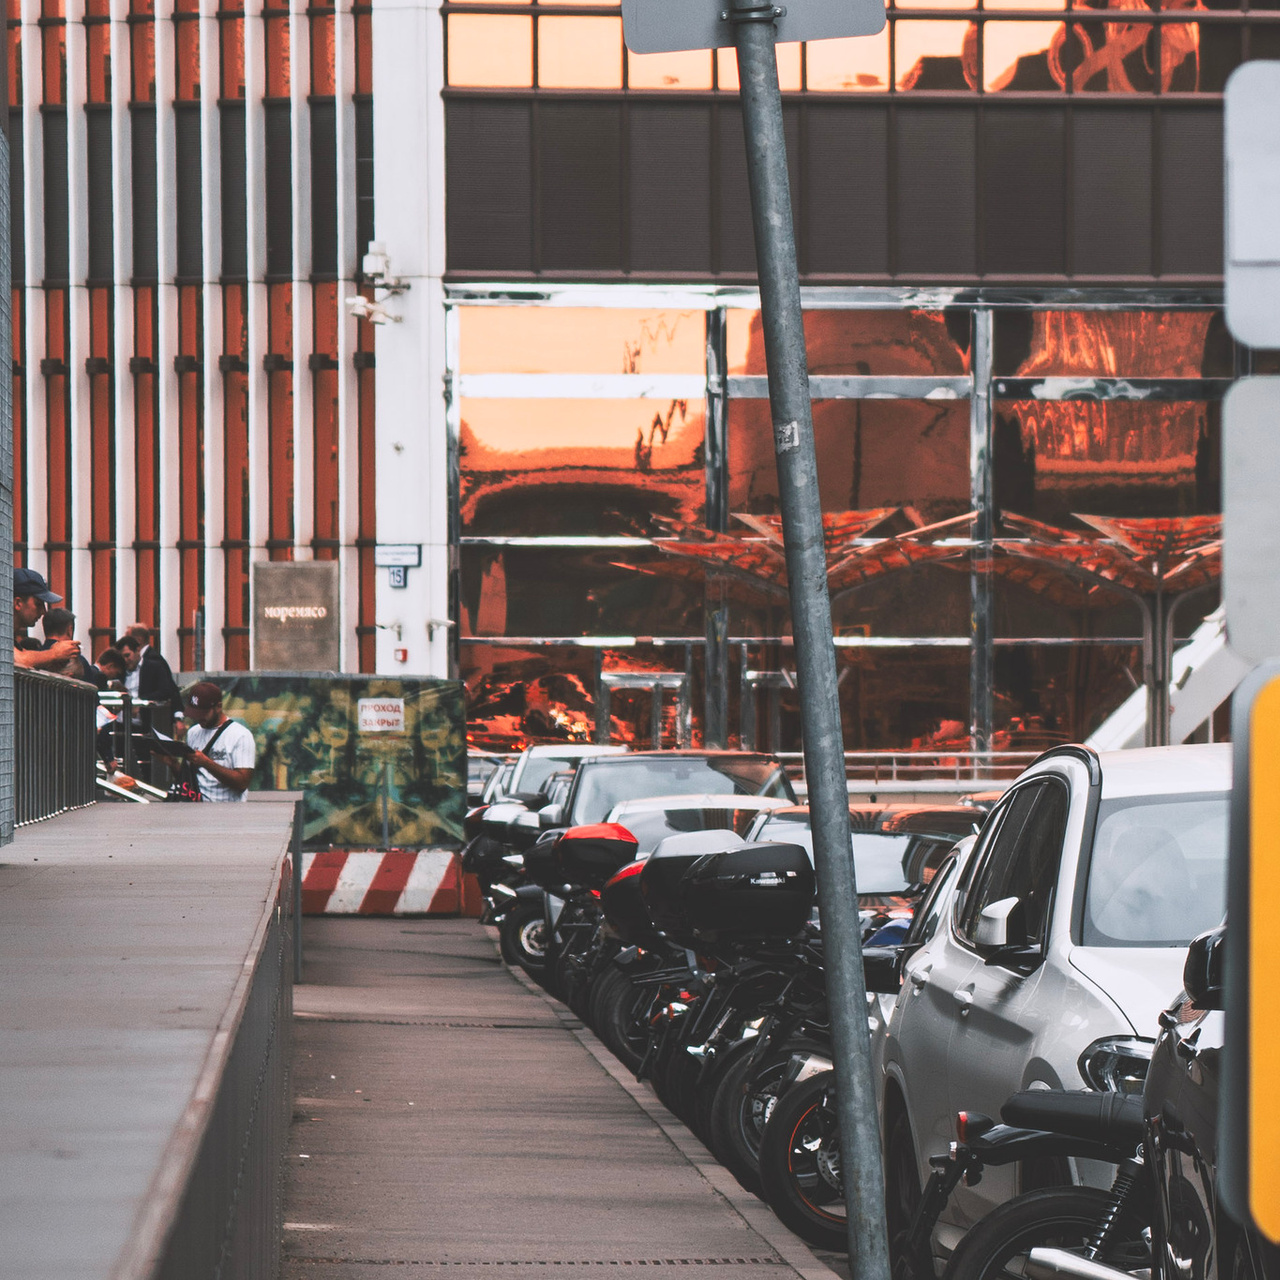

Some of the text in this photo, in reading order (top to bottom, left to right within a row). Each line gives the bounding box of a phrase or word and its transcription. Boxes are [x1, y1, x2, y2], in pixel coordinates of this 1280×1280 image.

[390, 569, 402, 584] 15
[264, 606, 327, 623] моремясо
[360, 704, 401, 714] ПРОХОД
[362, 718, 400, 727] ЗАКРЫТ
